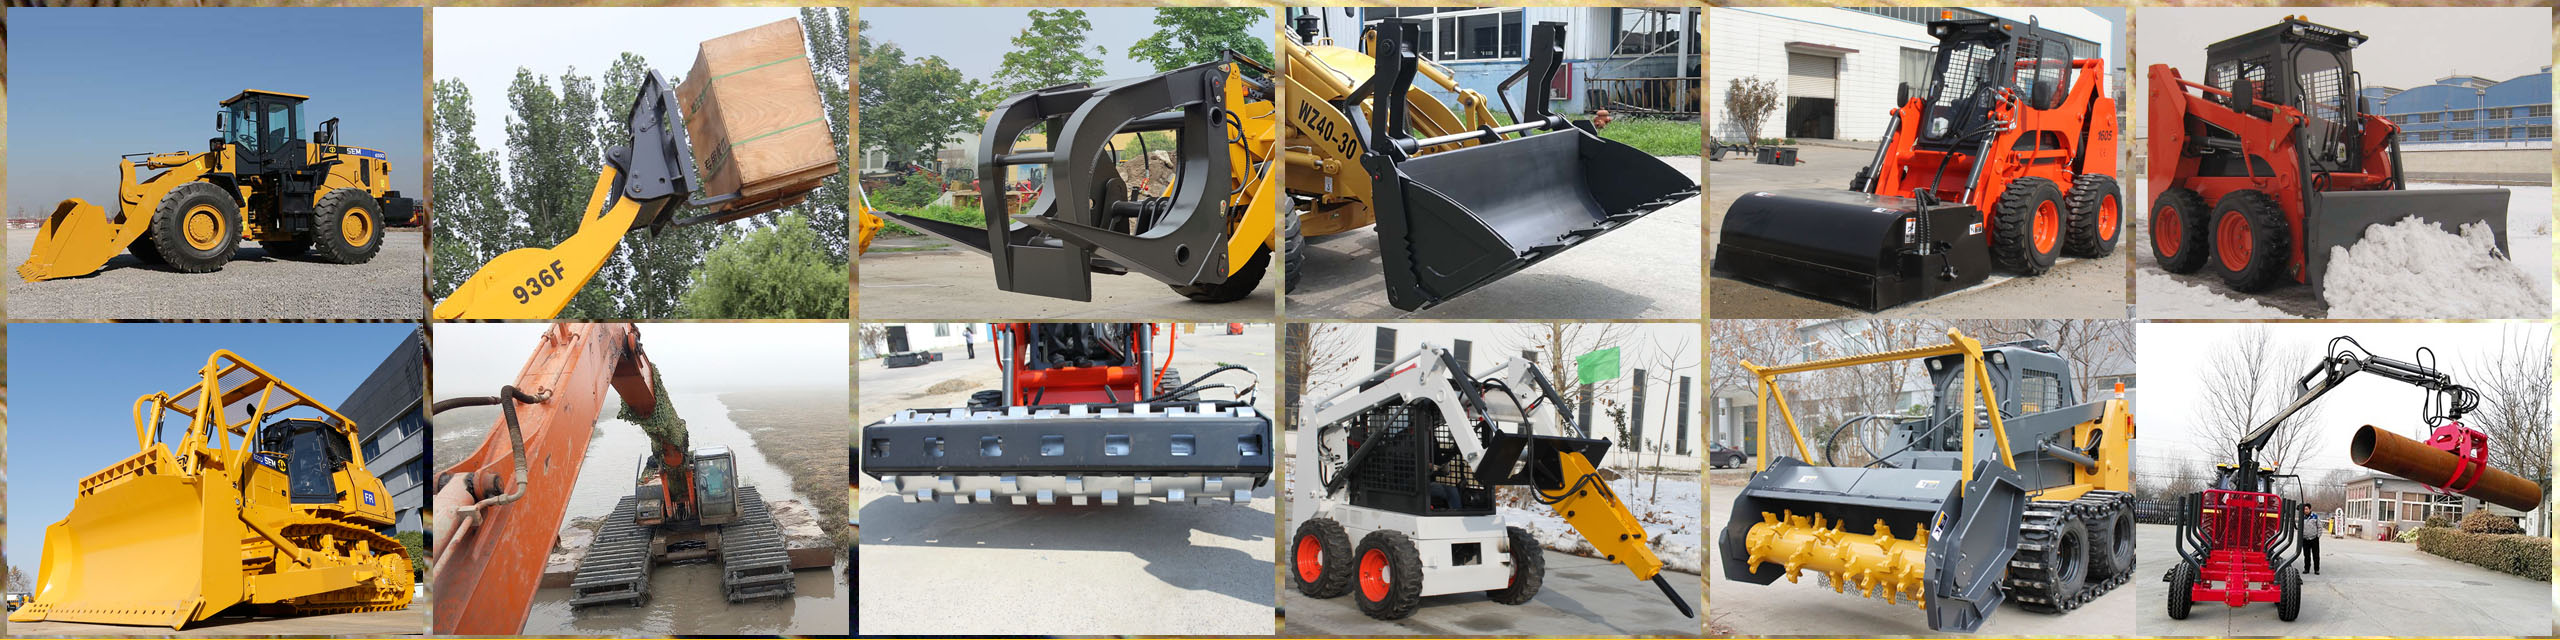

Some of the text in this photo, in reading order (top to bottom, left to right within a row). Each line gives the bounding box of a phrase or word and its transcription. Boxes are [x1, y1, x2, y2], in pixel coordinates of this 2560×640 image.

[1298, 99, 1357, 160] WZ40-30
[346, 147, 362, 155] SEM
[512, 258, 565, 305] 936F
[264, 456, 277, 469] SEM
[364, 492, 375, 504] FR
